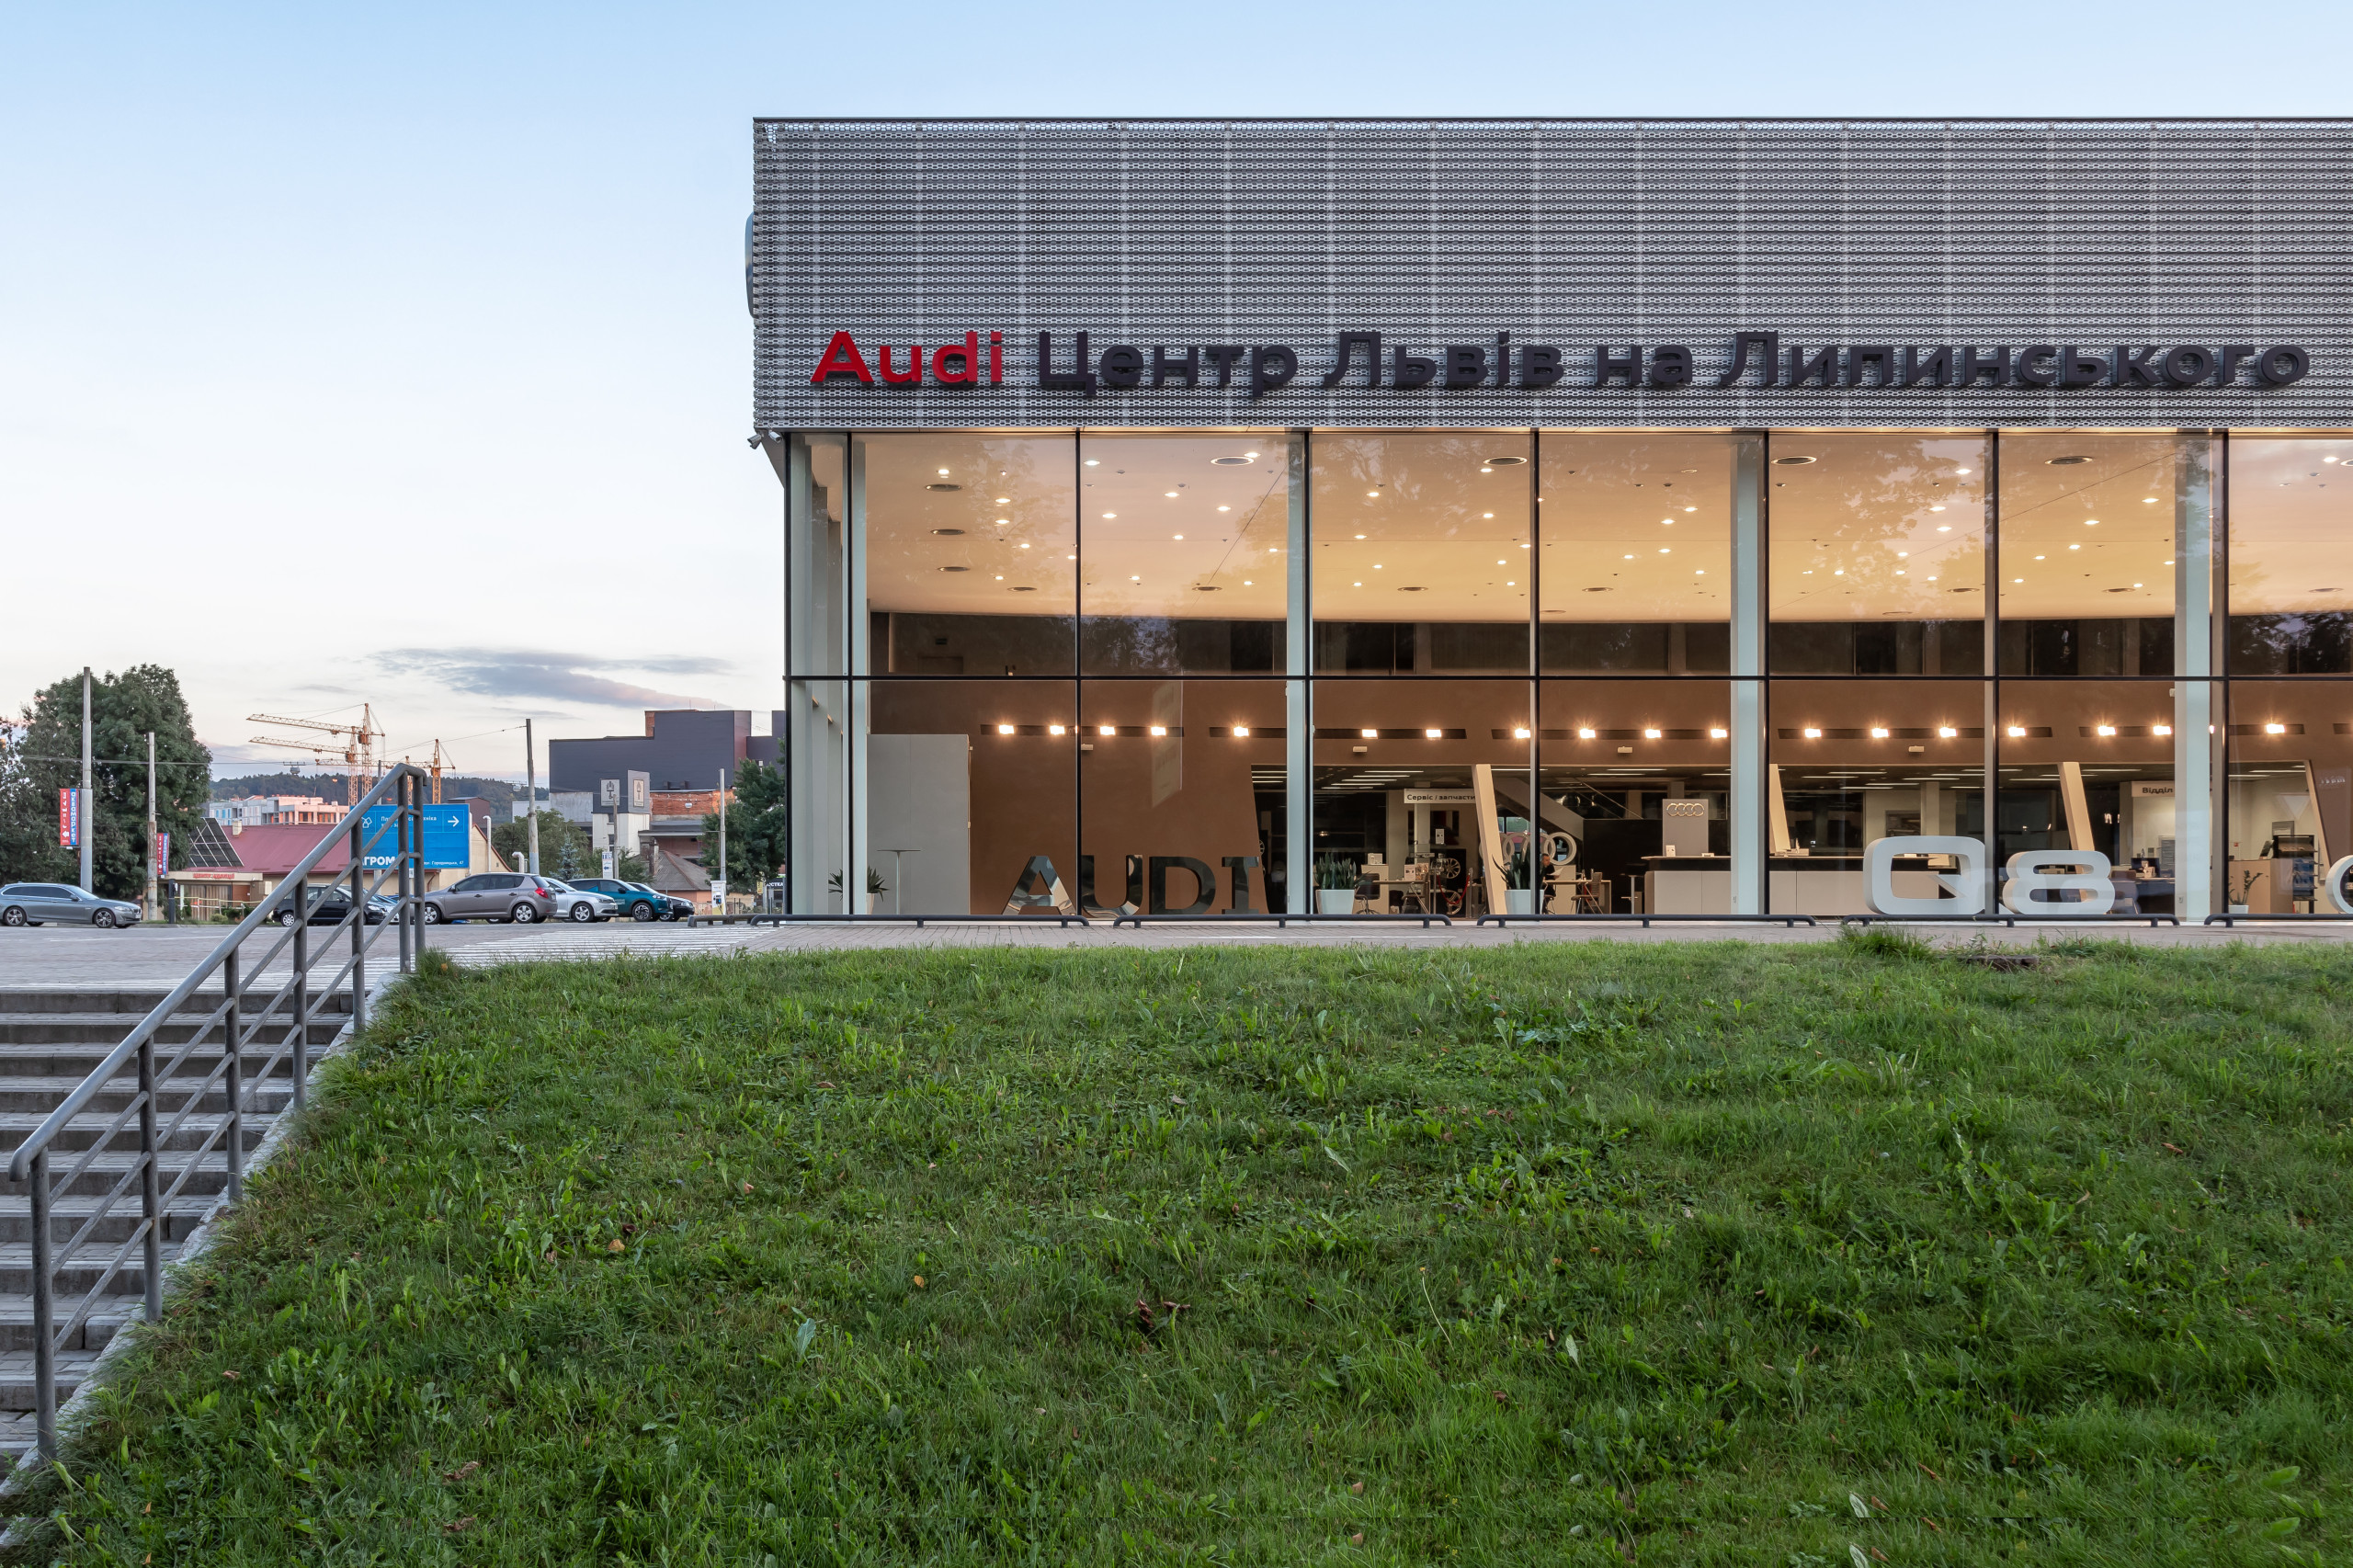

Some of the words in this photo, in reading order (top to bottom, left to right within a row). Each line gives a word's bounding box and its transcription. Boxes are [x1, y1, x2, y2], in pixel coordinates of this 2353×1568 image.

[811, 331, 1003, 384] Audi
[1038, 331, 1299, 399] Центр
[1324, 330, 1564, 386] Львів
[1594, 343, 1694, 386] на
[1717, 330, 2311, 386] Липинського
[1002, 854, 1260, 918] AUDI
